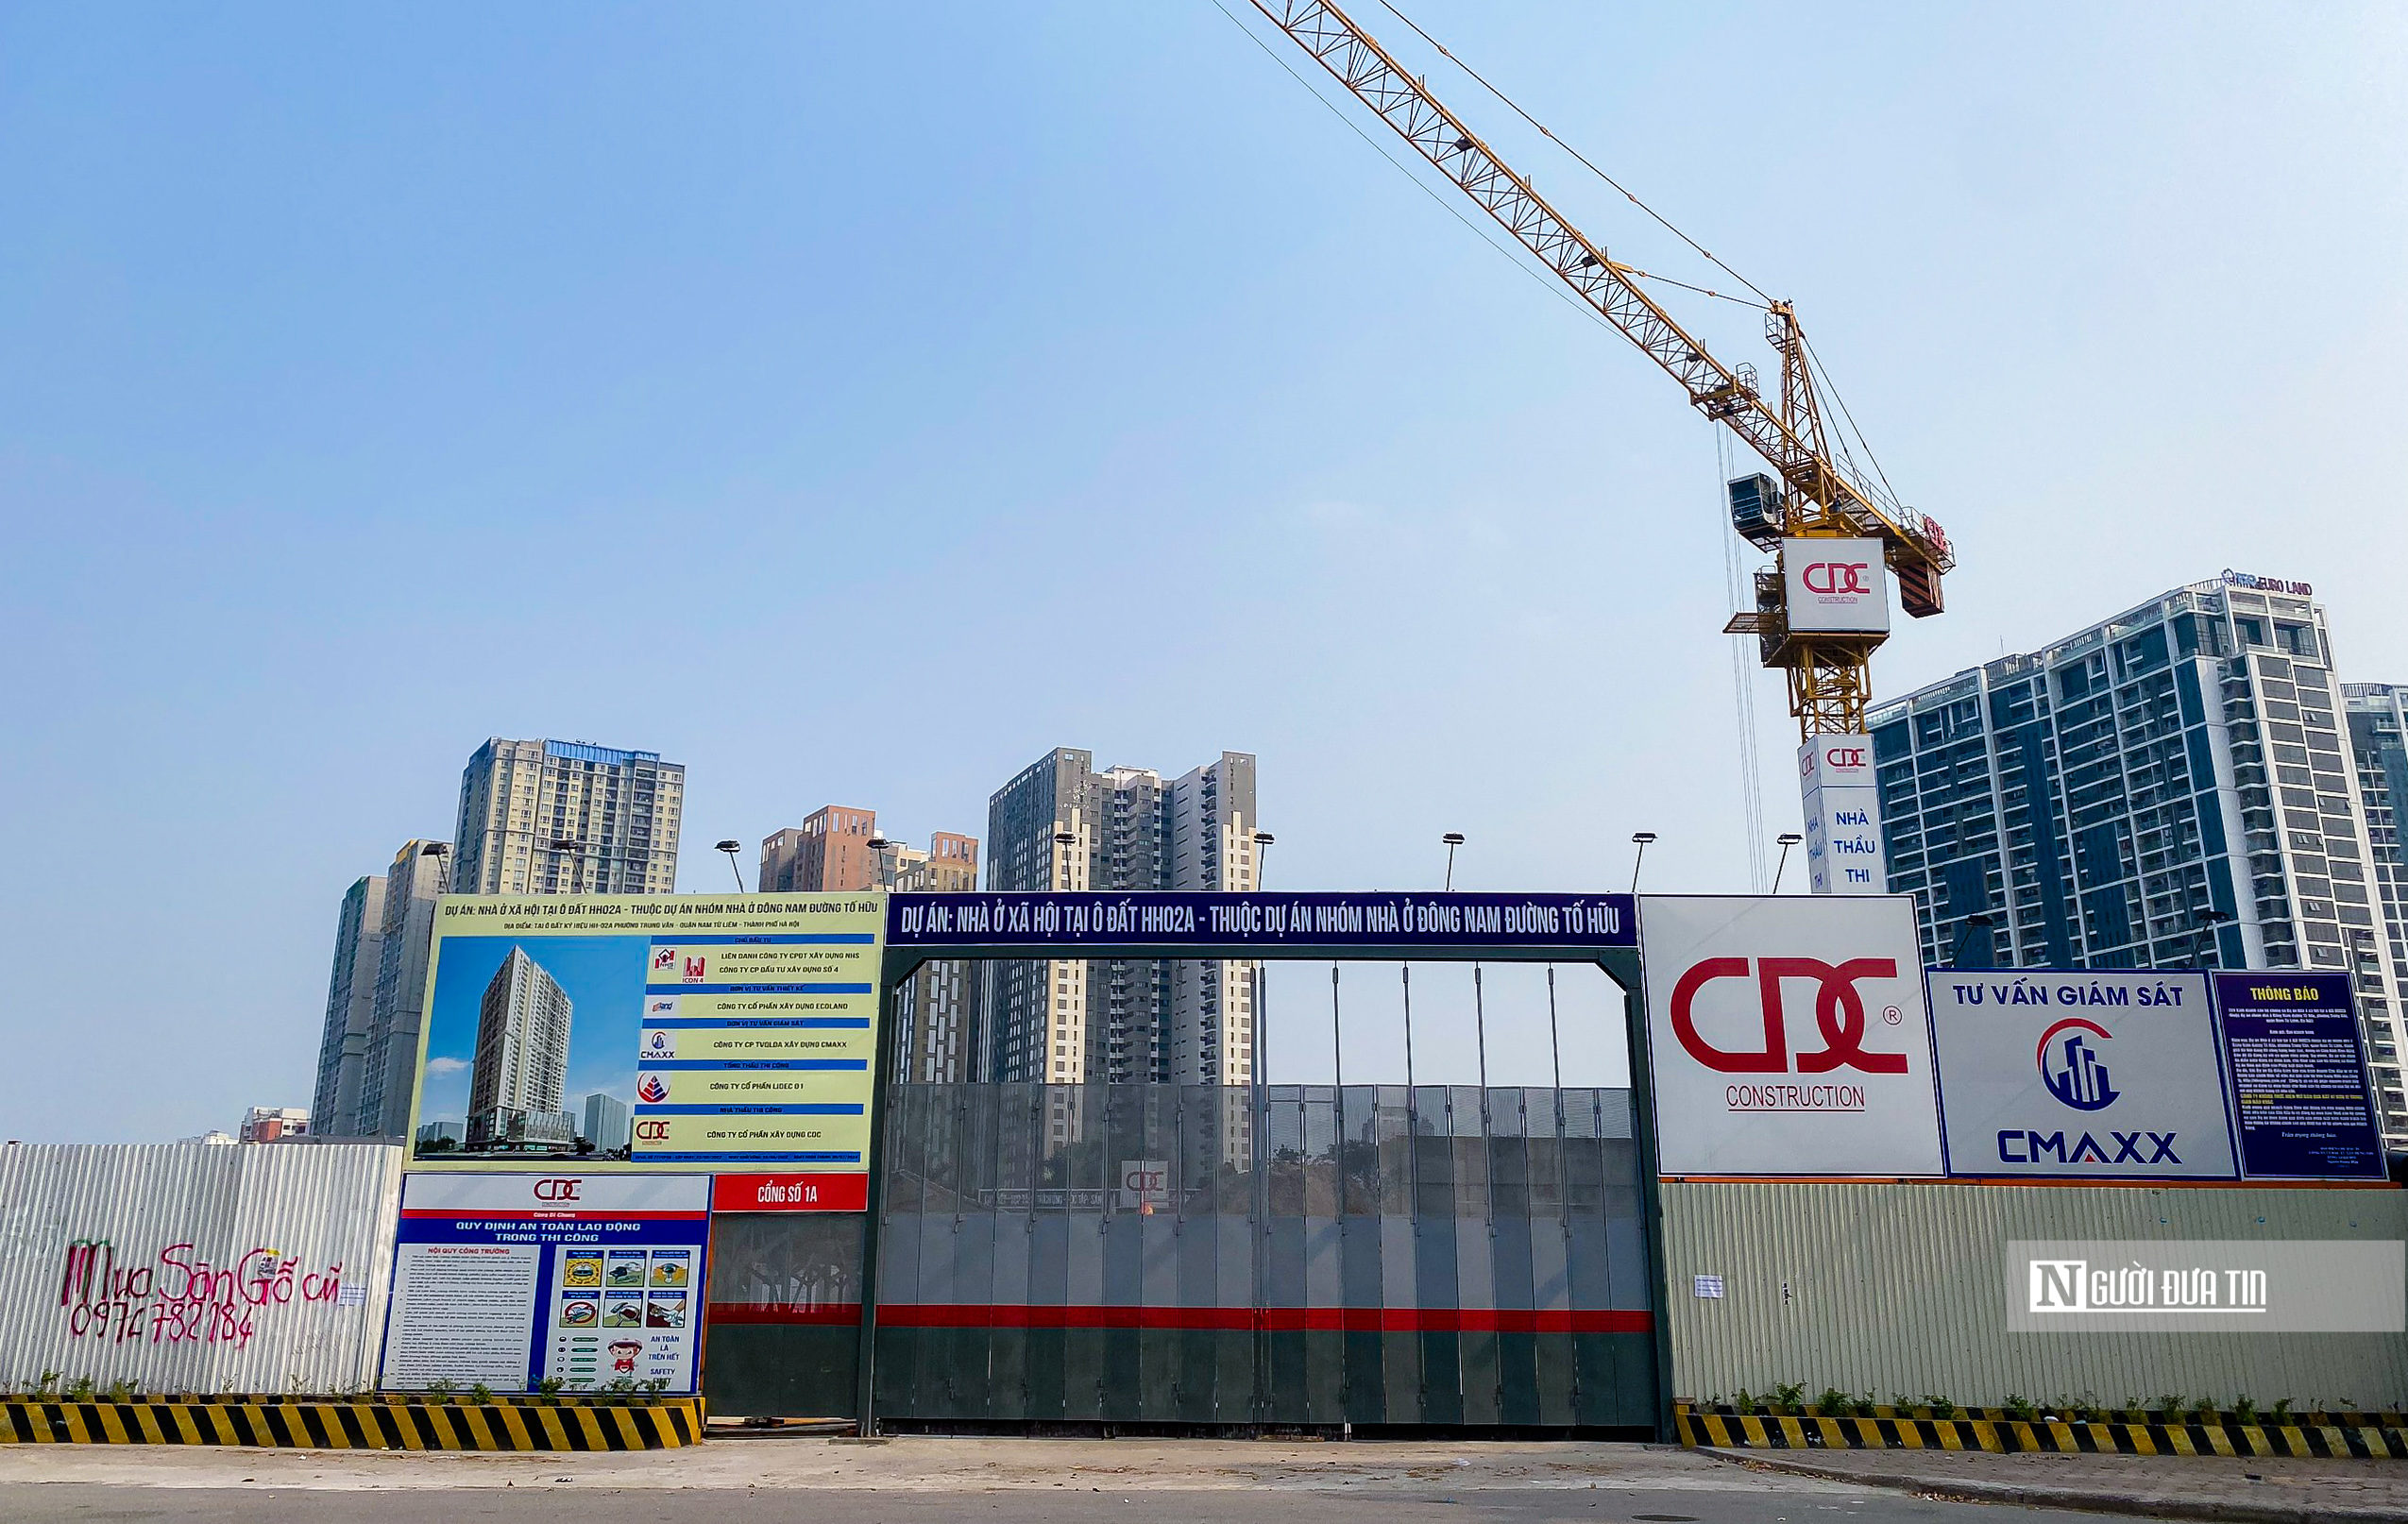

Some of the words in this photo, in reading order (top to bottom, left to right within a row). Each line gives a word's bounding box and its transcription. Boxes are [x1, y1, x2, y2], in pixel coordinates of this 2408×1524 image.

[1803, 563, 1871, 594] CDC
[1826, 748, 1866, 767] CDC
[1836, 807, 1870, 825] NHÀ
[1833, 835, 1876, 854] THẦU
[1845, 869, 1871, 883] THI
[445, 905, 459, 918] DỰ
[460, 904, 476, 915] ÁN:
[478, 904, 498, 915] NHÀ
[500, 902, 508, 915] Ở
[508, 904, 522, 915] XÃ
[524, 903, 540, 917] HỘI
[542, 905, 558, 917] TẠI
[560, 903, 567, 915] Ô
[568, 902, 587, 915] ĐẤT
[589, 905, 621, 915] HH02A
[631, 903, 661, 916] THUỘC
[664, 903, 677, 916] DỰ
[679, 902, 693, 914] ÁN
[695, 902, 723, 914] NHÓM
[725, 902, 746, 914] NHÀ
[748, 900, 755, 913] Ở
[756, 902, 783, 913] ĐÔNG
[785, 903, 806, 913] NAM
[809, 902, 841, 913] ĐƯỜNG
[843, 900, 857, 913] TỐ
[857, 902, 878, 913] HỮU
[902, 905, 924, 938] DỰ
[926, 901, 953, 933] ÁN:
[957, 901, 989, 933] NHÀ
[993, 898, 1006, 933] Ở
[1009, 901, 1029, 933] XÃ
[1033, 901, 1060, 938] HỘI
[1064, 906, 1089, 938] TẠI
[1093, 901, 1103, 933] Ô
[1107, 898, 1138, 933] ĐẤT
[1141, 906, 1195, 933] HH02A
[1210, 901, 1261, 938] THUỘC
[1265, 904, 1287, 938] DỰ
[1290, 901, 1312, 933] ÁN
[1315, 901, 1363, 933] NHÓM
[1366, 901, 1399, 933] NHÀ
[1403, 897, 1415, 933] Ở
[1417, 901, 1461, 933] ĐÔNG
[1465, 906, 1501, 933] NAM
[1504, 901, 1558, 934] ĐƯỜNG
[1562, 899, 1585, 934] TỐ
[1587, 902, 1619, 934] HỮU
[1952, 982, 1984, 1006] TƯ
[1991, 976, 2049, 1006] VẤN
[2057, 980, 2129, 1007] GIÁM
[2137, 980, 2183, 1007] SÁT
[2250, 985, 2292, 1001] THÔNG
[2294, 986, 2319, 1001] BÁO
[1670, 957, 1908, 1075] CDC
[1726, 1085, 1865, 1108] CONSTRUCTION
[636, 1121, 670, 1140] CDC
[1996, 1128, 2183, 1164] CMAXX
[534, 1178, 582, 1201] CDC
[757, 1179, 786, 1203] CỔNG
[788, 1181, 804, 1203] SỐ
[805, 1186, 818, 1203] 1A
[456, 1222, 480, 1231] QUY
[483, 1222, 516, 1232] ĐỊNH
[518, 1222, 537, 1231] AN
[540, 1220, 574, 1231] TOÀN
[577, 1223, 602, 1231] LAO
[605, 1221, 641, 1232] ĐỘNG
[495, 1233, 537, 1242] TRONG
[540, 1233, 561, 1242] THI
[564, 1232, 600, 1242] CÔNG
[60, 1239, 153, 1307] Mua
